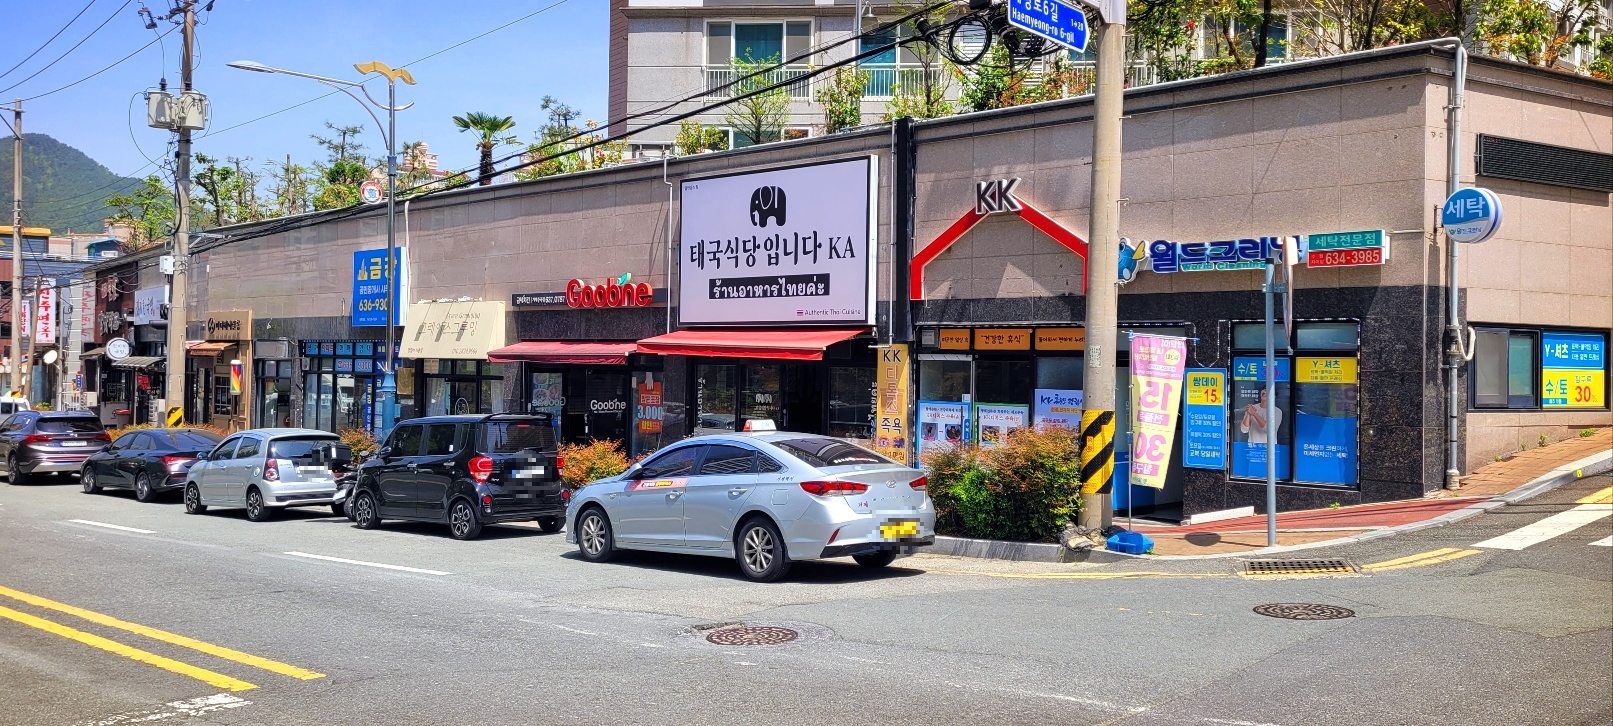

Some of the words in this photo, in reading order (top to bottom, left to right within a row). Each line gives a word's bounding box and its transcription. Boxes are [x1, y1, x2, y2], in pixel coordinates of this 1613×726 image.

[1017, 0, 1058, 22] 로6길
[1012, 7, 1058, 36] Haemyeong-ro
[1060, 28, 1075, 43] 6-gil
[976, 177, 1022, 214] KK
[1446, 197, 1485, 218] 세탁
[828, 236, 856, 260] KA
[1315, 232, 1376, 247] 세탁전문점
[1182, 263, 1214, 271] World
[1217, 261, 1267, 270] Cleaning
[1325, 250, 1380, 265] 634-3985
[713, 276, 825, 298] ร้านอาหารไทยค่ะ
[883, 349, 901, 363] KK
[1238, 362, 1257, 375] 수/토
[886, 364, 899, 414] 디톡스
[1546, 379, 1567, 395] 수/토
[637, 405, 663, 420] 3,000
[881, 417, 902, 434] 족욕
